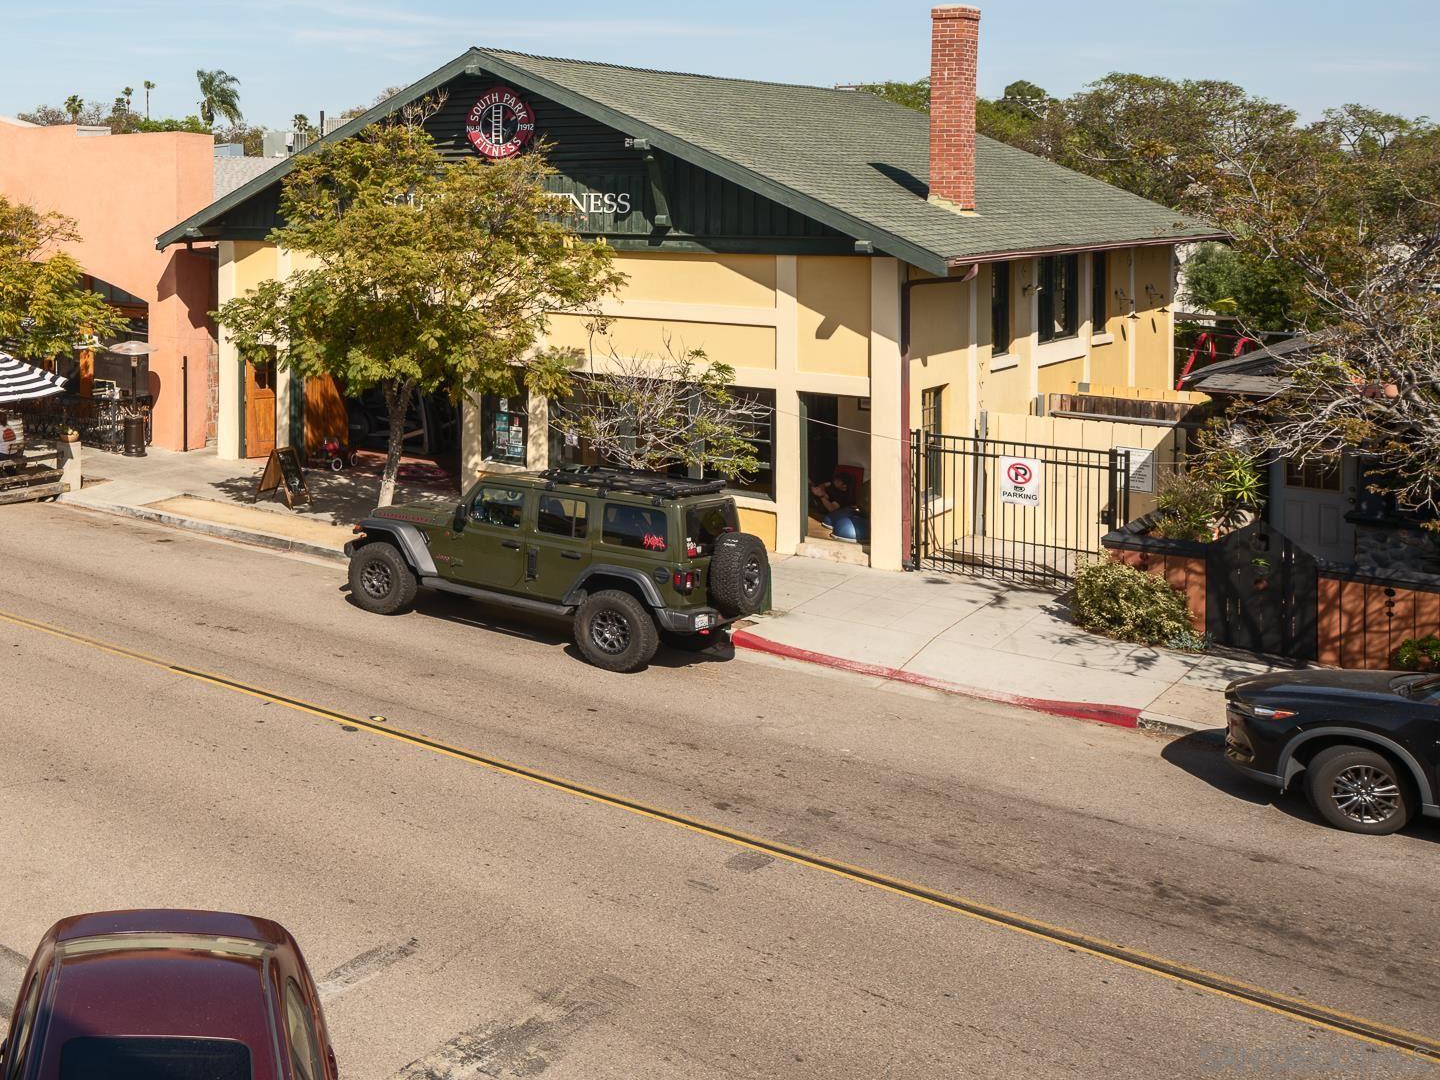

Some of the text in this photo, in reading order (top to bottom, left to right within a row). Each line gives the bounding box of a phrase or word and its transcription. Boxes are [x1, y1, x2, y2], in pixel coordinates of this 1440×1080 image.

[471, 92, 528, 122] SOUTH PARK
[519, 123, 534, 131] 1912
[474, 136, 522, 157] FITNESS
[532, 192, 631, 214] NESS
[1002, 491, 1038, 501] PARKING
